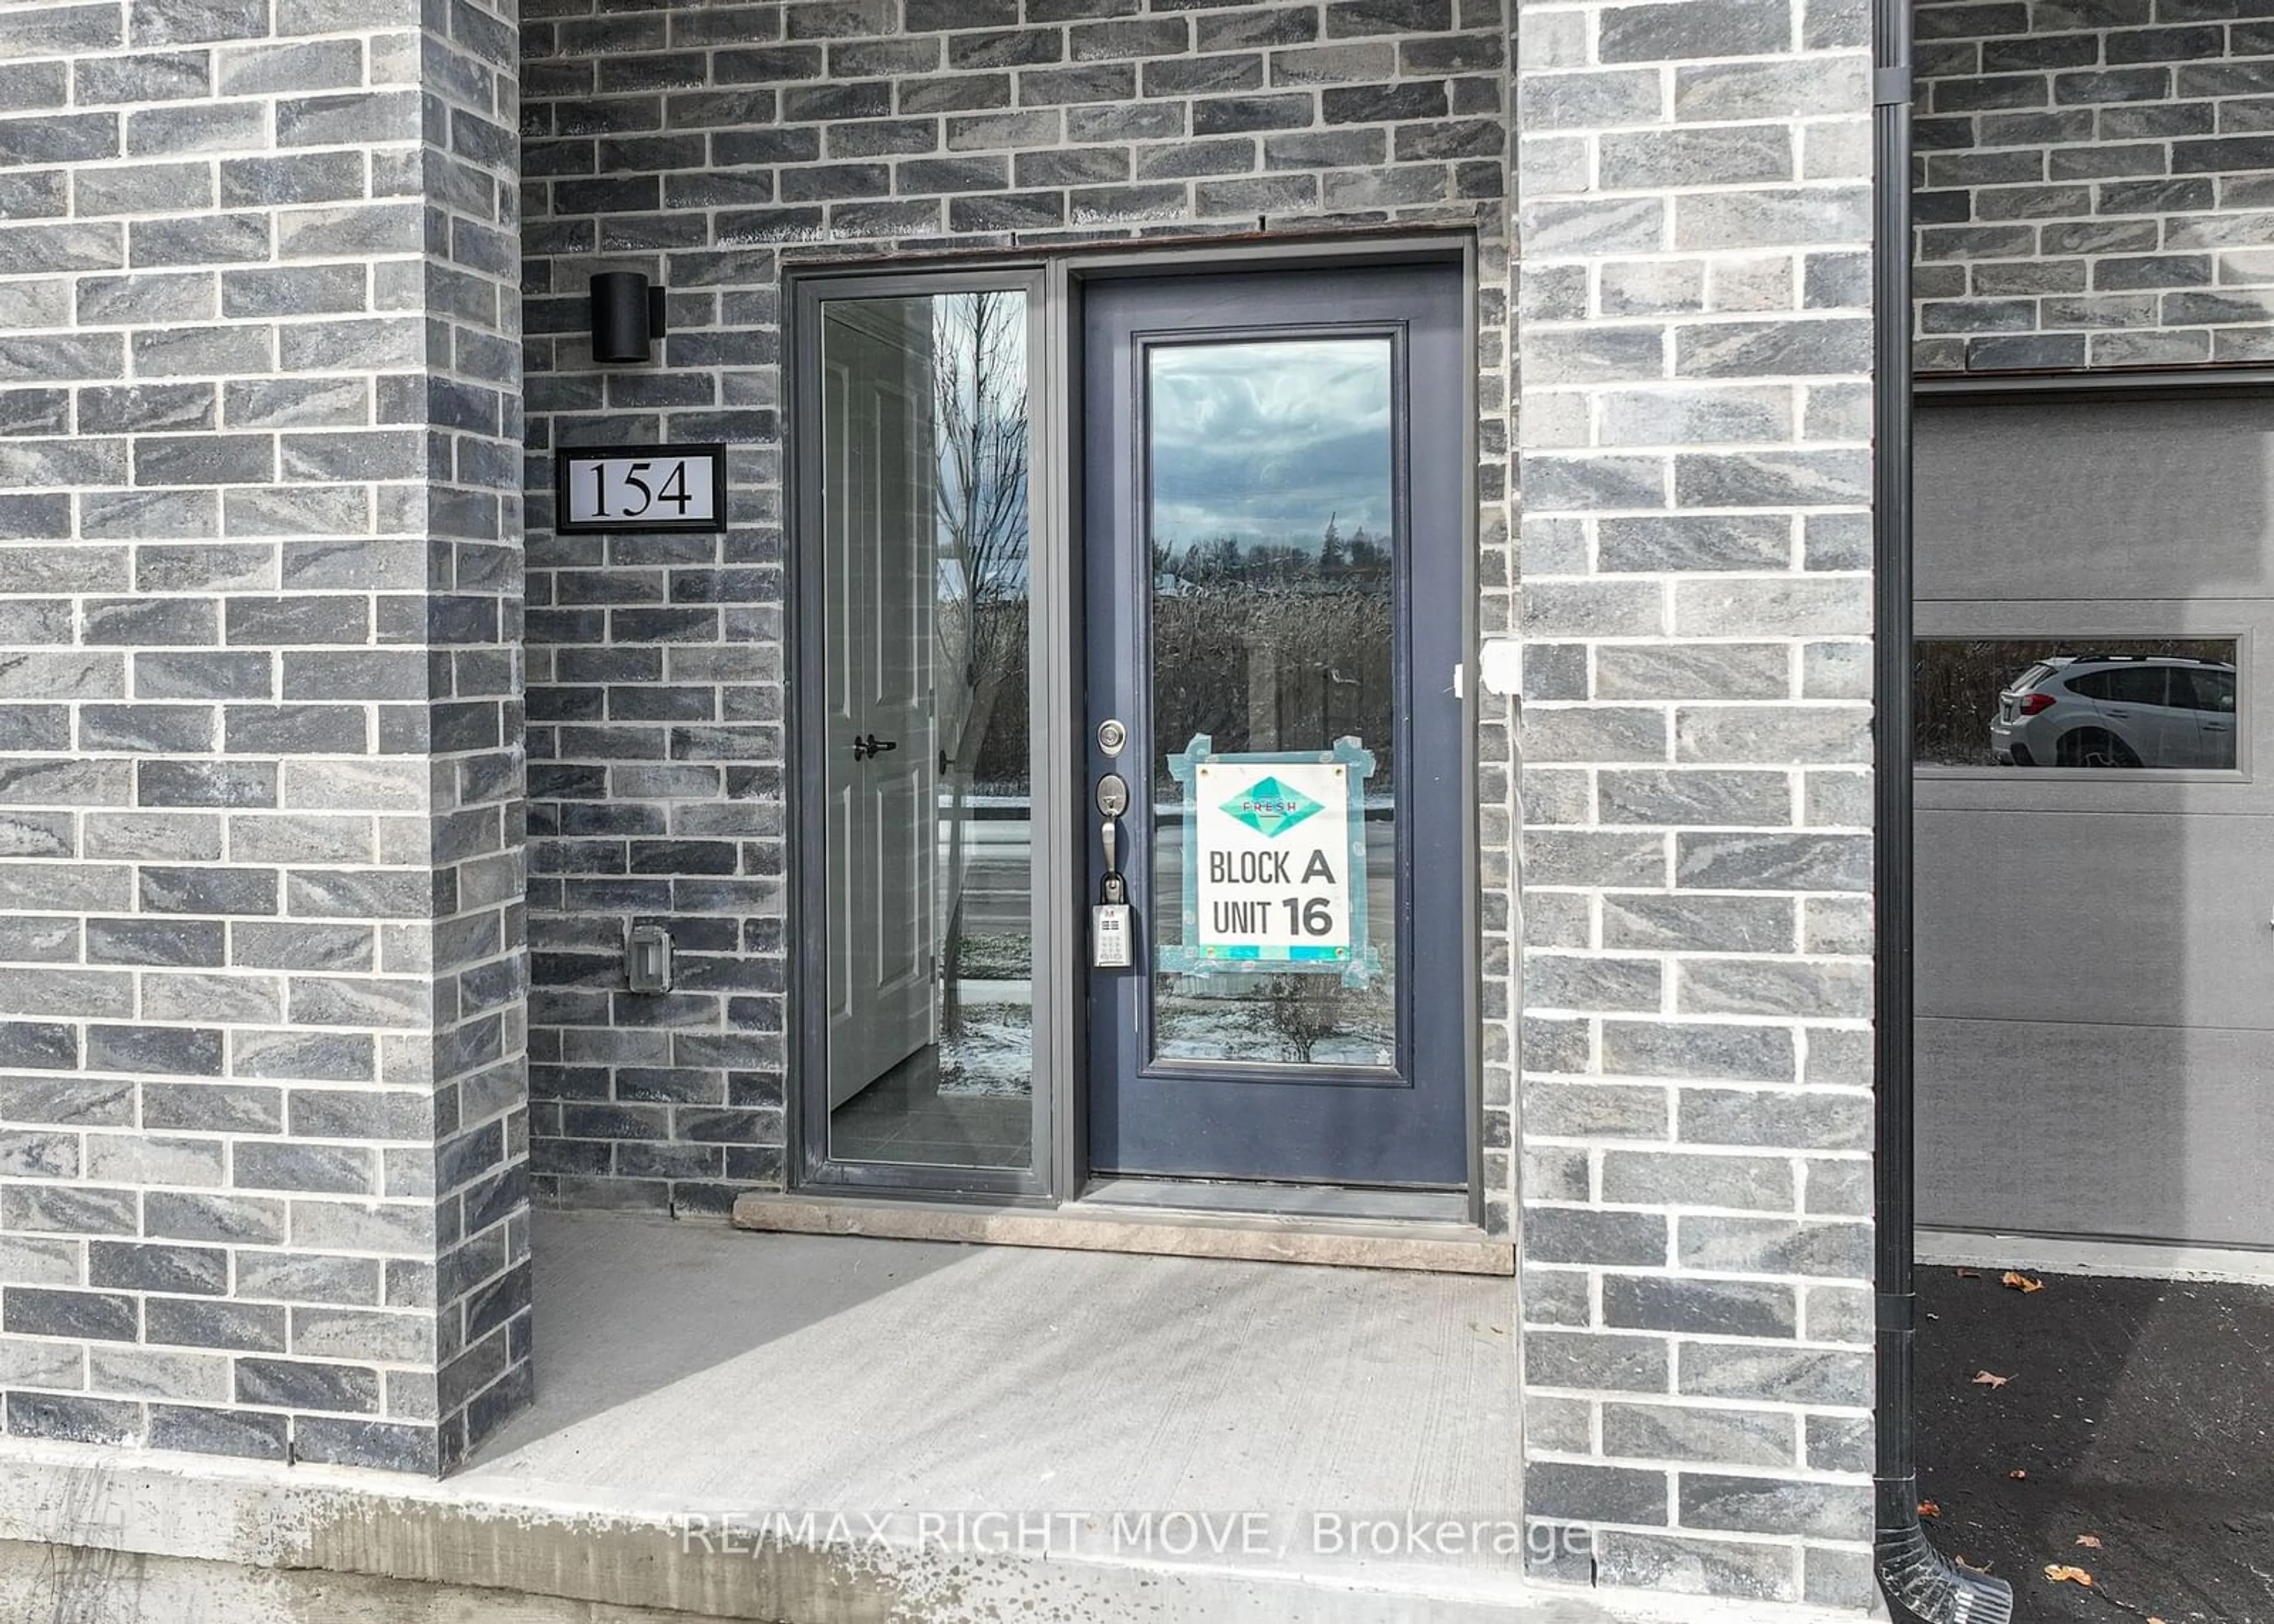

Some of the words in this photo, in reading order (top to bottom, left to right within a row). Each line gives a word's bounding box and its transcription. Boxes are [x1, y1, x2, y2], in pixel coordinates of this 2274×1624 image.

[590, 460, 692, 517] 154
[1243, 802, 1296, 812] FRESH
[1210, 850, 1291, 884] BLOCK
[1300, 849, 1336, 884] A
[1213, 901, 1272, 934] UNIT
[1281, 897, 1333, 936] 16
